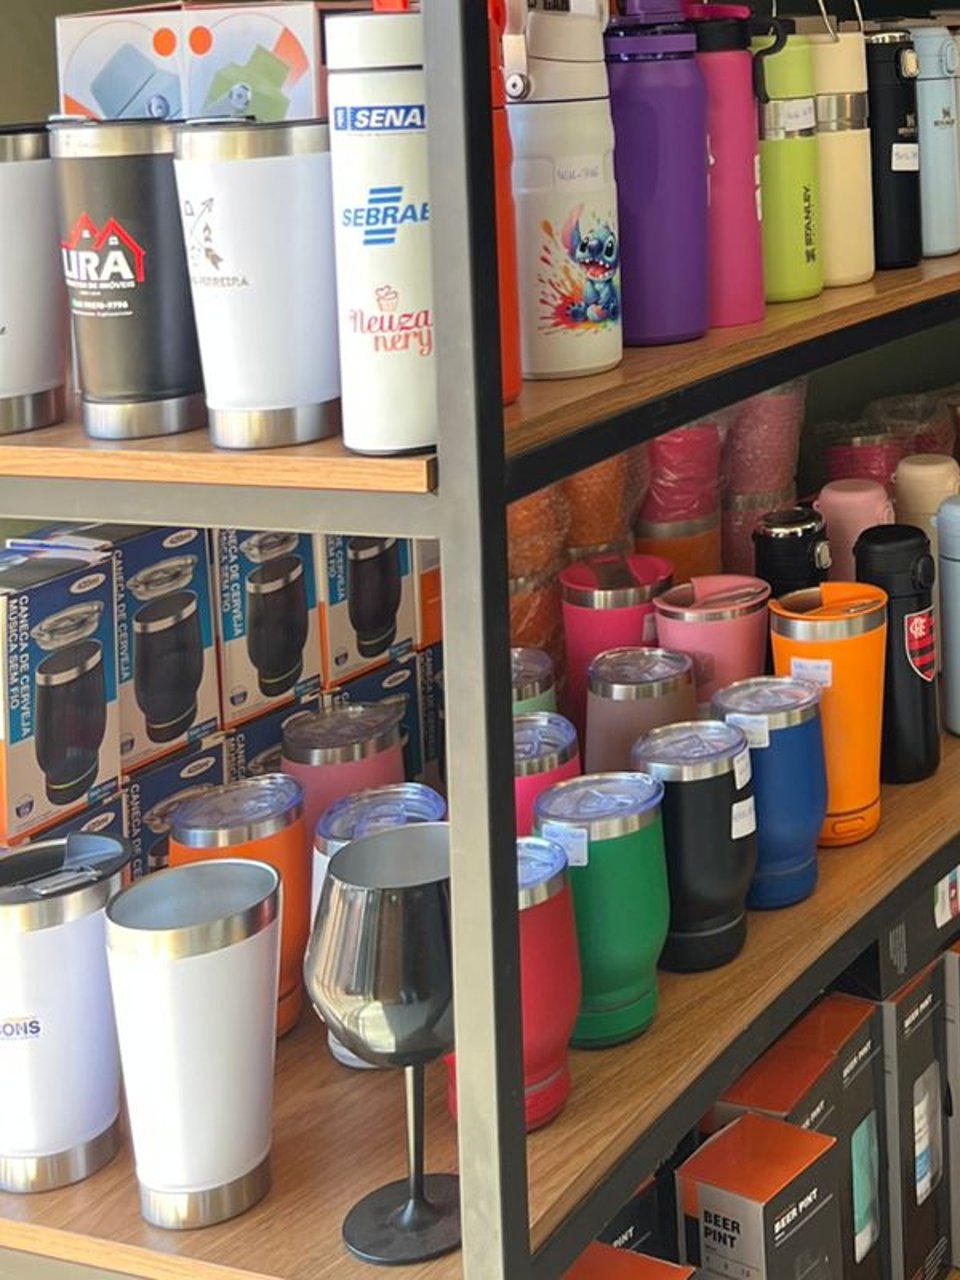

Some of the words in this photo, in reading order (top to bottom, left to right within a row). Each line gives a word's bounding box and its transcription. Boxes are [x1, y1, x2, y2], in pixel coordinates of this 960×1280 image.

[354, 106, 427, 129] SENA
[373, 324, 433, 358] nery
[18, 595, 30, 652] CANECA
[231, 583, 244, 637] CERVEJA
[19, 653, 30, 673] DE
[118, 623, 130, 682] CERVEJA
[8, 655, 19, 685] SEM
[9, 687, 20, 709] FIO
[20, 675, 31, 738] CERVEJA
[130, 784, 141, 837] CANECA
[2, 1019, 41, 1037] ONS
[703, 1210, 742, 1235] BEER
[773, 1207, 798, 1235] BEER
[798, 1187, 819, 1214] PINT
[703, 1226, 737, 1250] PINT
